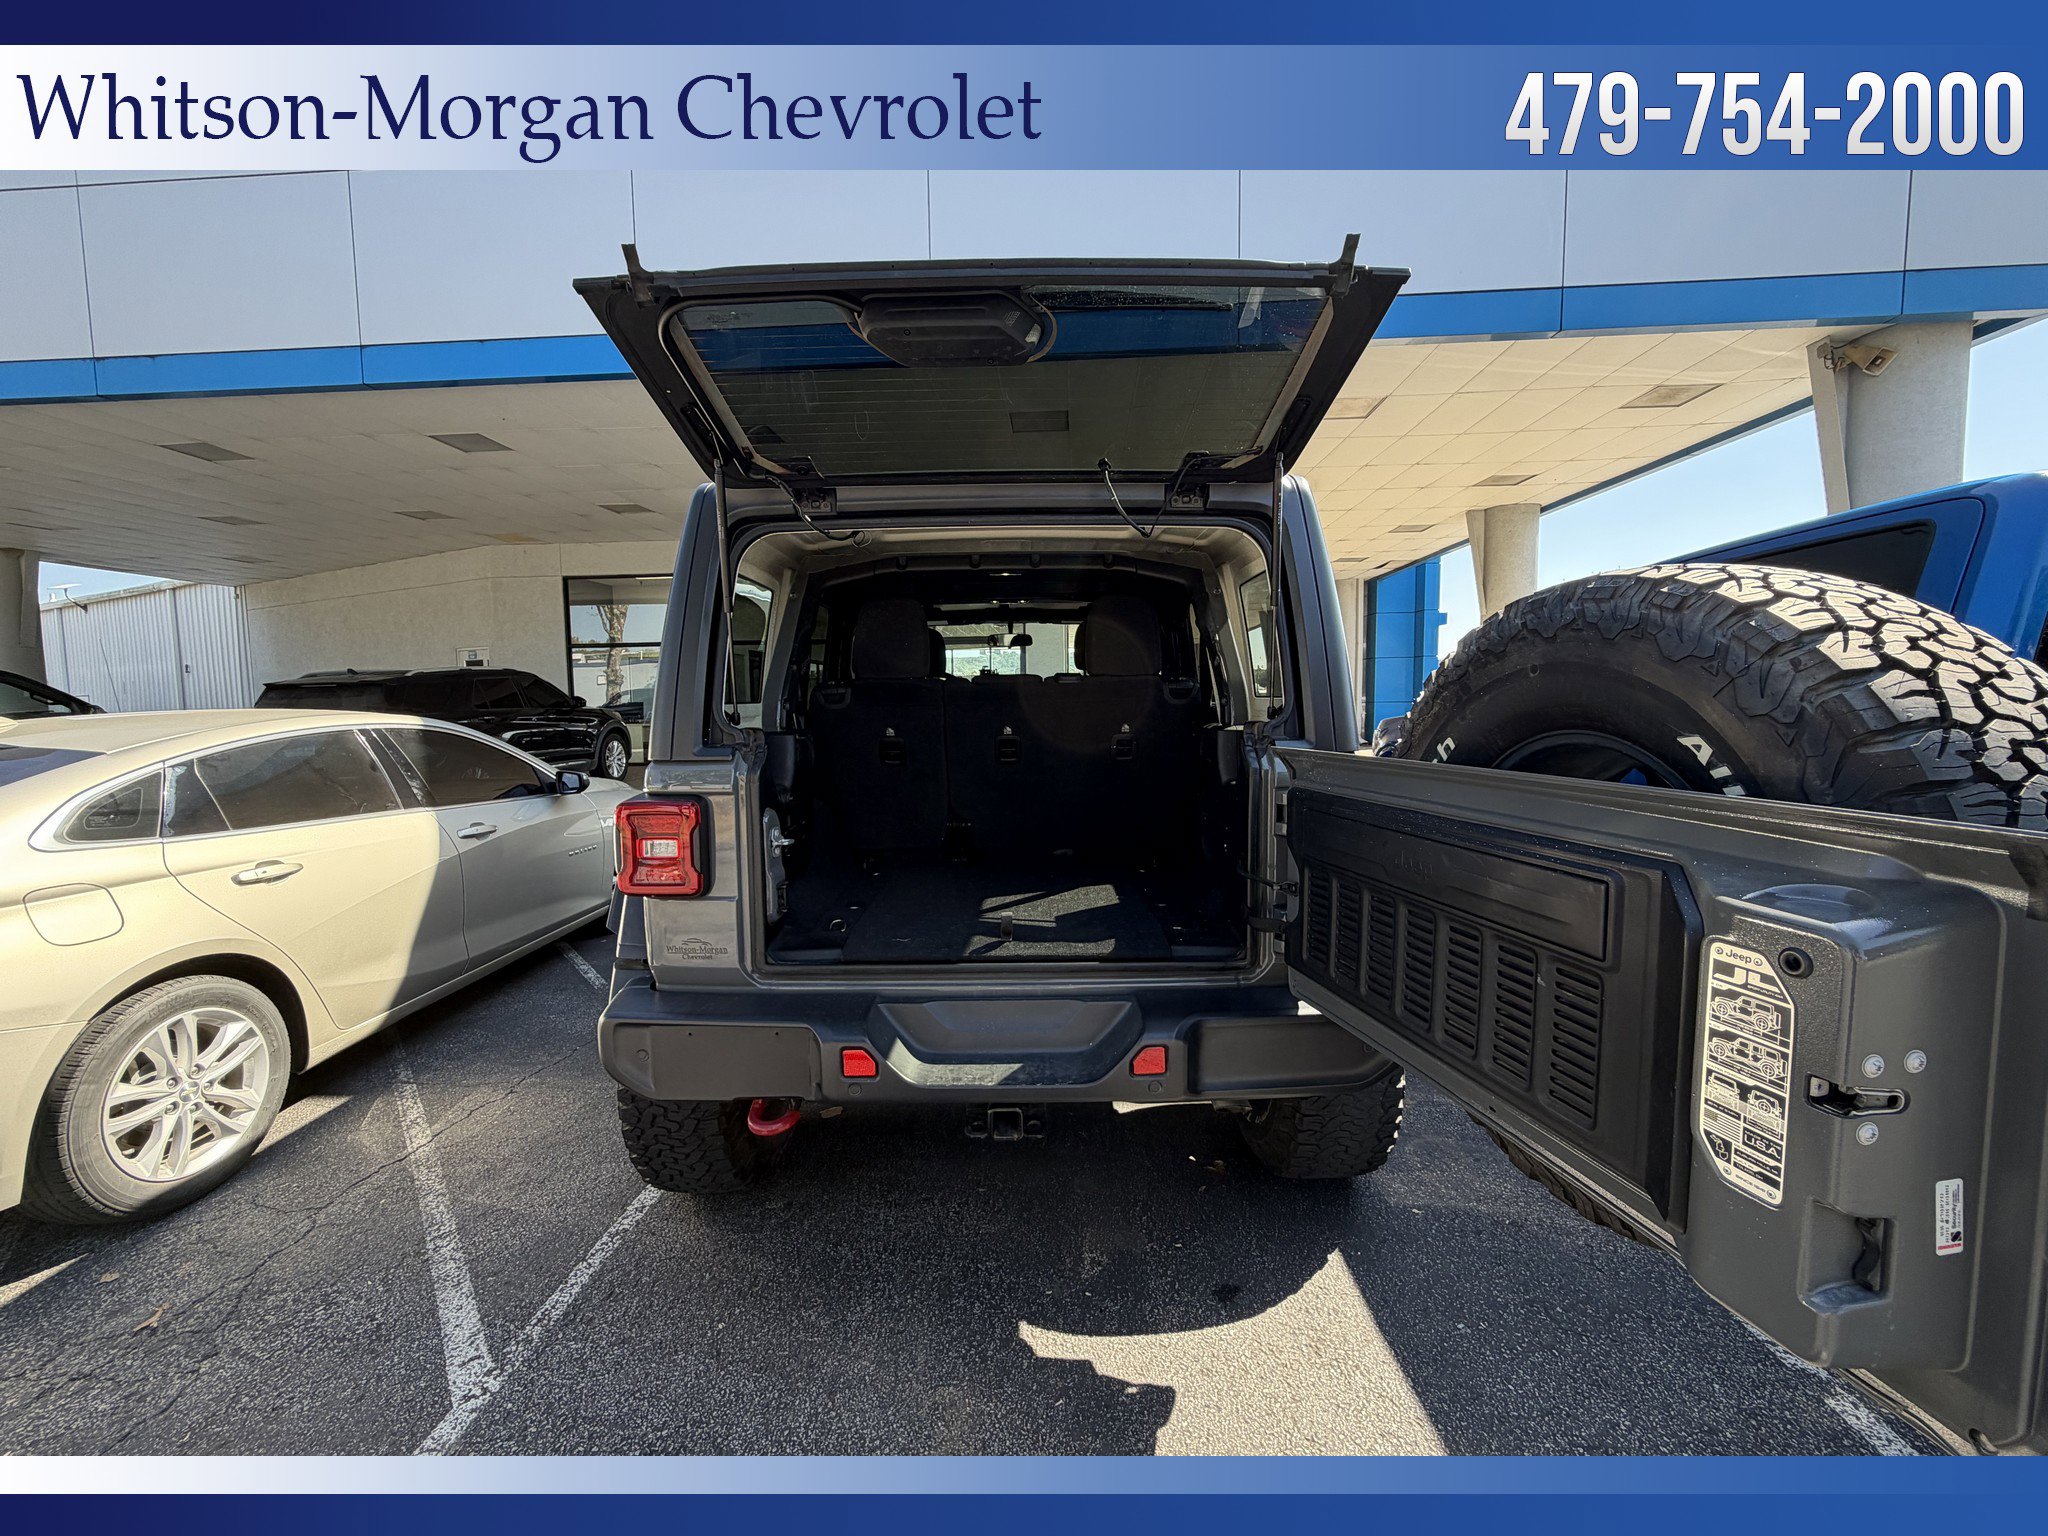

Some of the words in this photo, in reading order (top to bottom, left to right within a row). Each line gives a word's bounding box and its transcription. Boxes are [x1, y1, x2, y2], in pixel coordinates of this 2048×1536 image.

[666, 945, 728, 955] Whitson-Morgan
[1725, 949, 1752, 964] Jeep
[1713, 967, 1781, 993] JL
